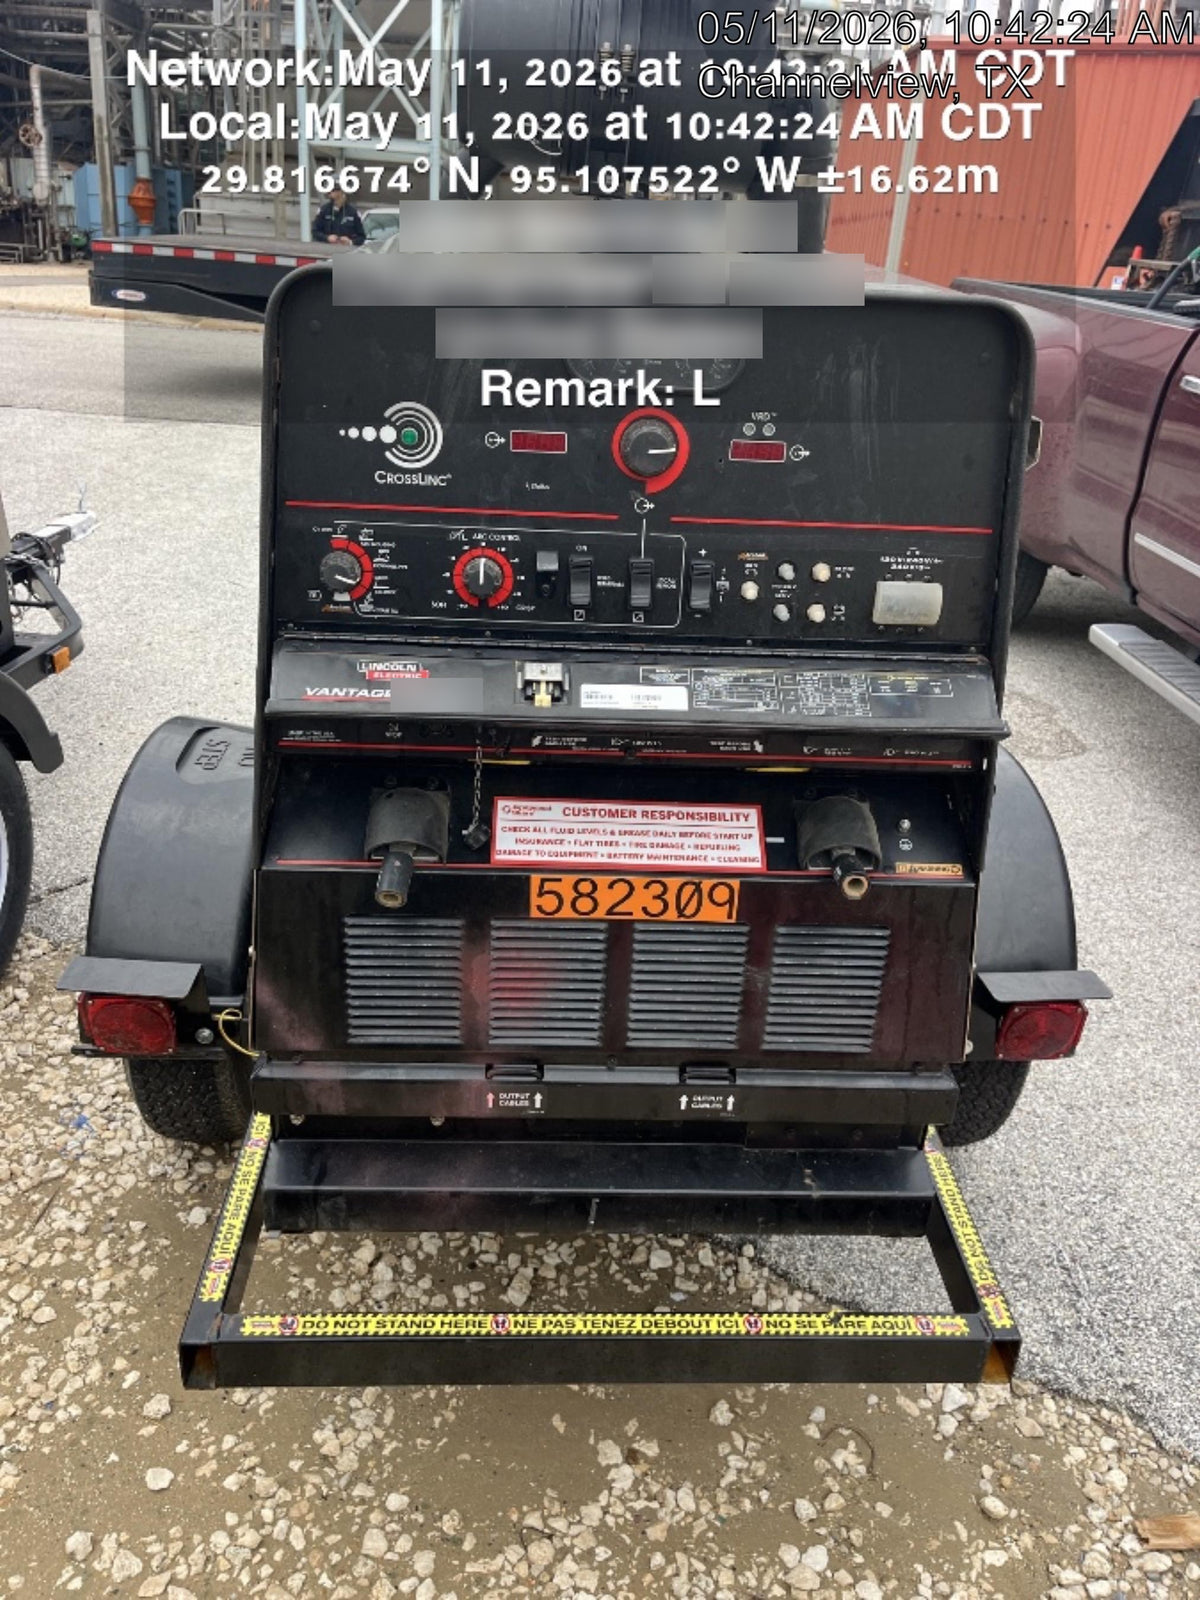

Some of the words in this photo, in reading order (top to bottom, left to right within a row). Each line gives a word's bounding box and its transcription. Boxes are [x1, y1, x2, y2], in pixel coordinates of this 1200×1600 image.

[361, 661, 418, 671] LINCOLN
[562, 806, 637, 819] CUSTOMER
[641, 809, 750, 822] RESPONSIBILITY
[532, 826, 548, 834] ALL
[550, 827, 575, 835] FLUID
[577, 827, 608, 836] LEVELS
[652, 830, 676, 838] DAILY
[678, 831, 712, 839] BEFORE
[515, 837, 565, 845] INSURANCE
[573, 838, 595, 847] FLAT
[595, 839, 620, 847] TIRES
[648, 841, 685, 850] DAMAGE
[534, 849, 546, 857] TO
[548, 850, 598, 858] EQUIPMENT
[606, 852, 645, 860] BATTERY
[646, 853, 709, 862] MAINTENANCE
[535, 877, 736, 920] 582309
[499, 1099, 530, 1107] CABLES
[301, 1320, 329, 1329] DO
[333, 1320, 371, 1329] NOT
[375, 1319, 436, 1329] STAND
[440, 1320, 488, 1329] HERE
[513, 1318, 538, 1329] NE
[541, 1318, 577, 1329] PAS
[580, 1318, 637, 1329] TENEZ
[641, 1319, 712, 1329] DEBOUT
[716, 1318, 740, 1329] ICI
[765, 1319, 790, 1330] NO
[796, 1319, 818, 1330] SE
